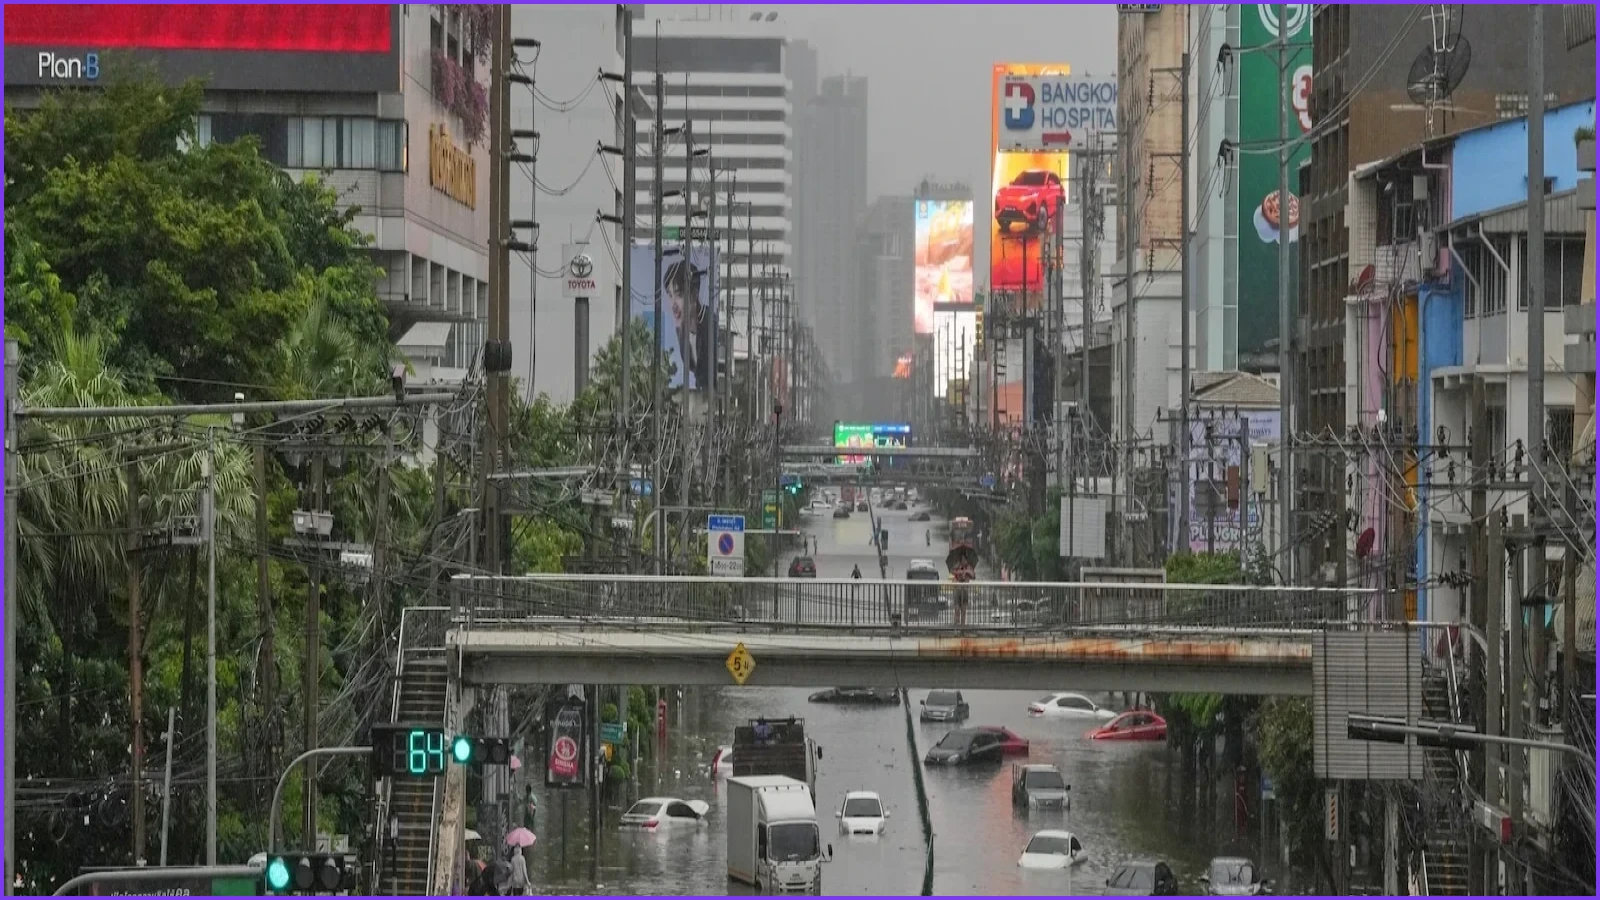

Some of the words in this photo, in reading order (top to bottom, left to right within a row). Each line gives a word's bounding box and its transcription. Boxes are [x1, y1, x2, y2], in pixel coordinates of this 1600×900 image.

[1041, 107, 1117, 128] HOSPITA
[568, 280, 596, 290] TOYOTA
[734, 656, 742, 671] 5
[410, 731, 443, 773] 64
